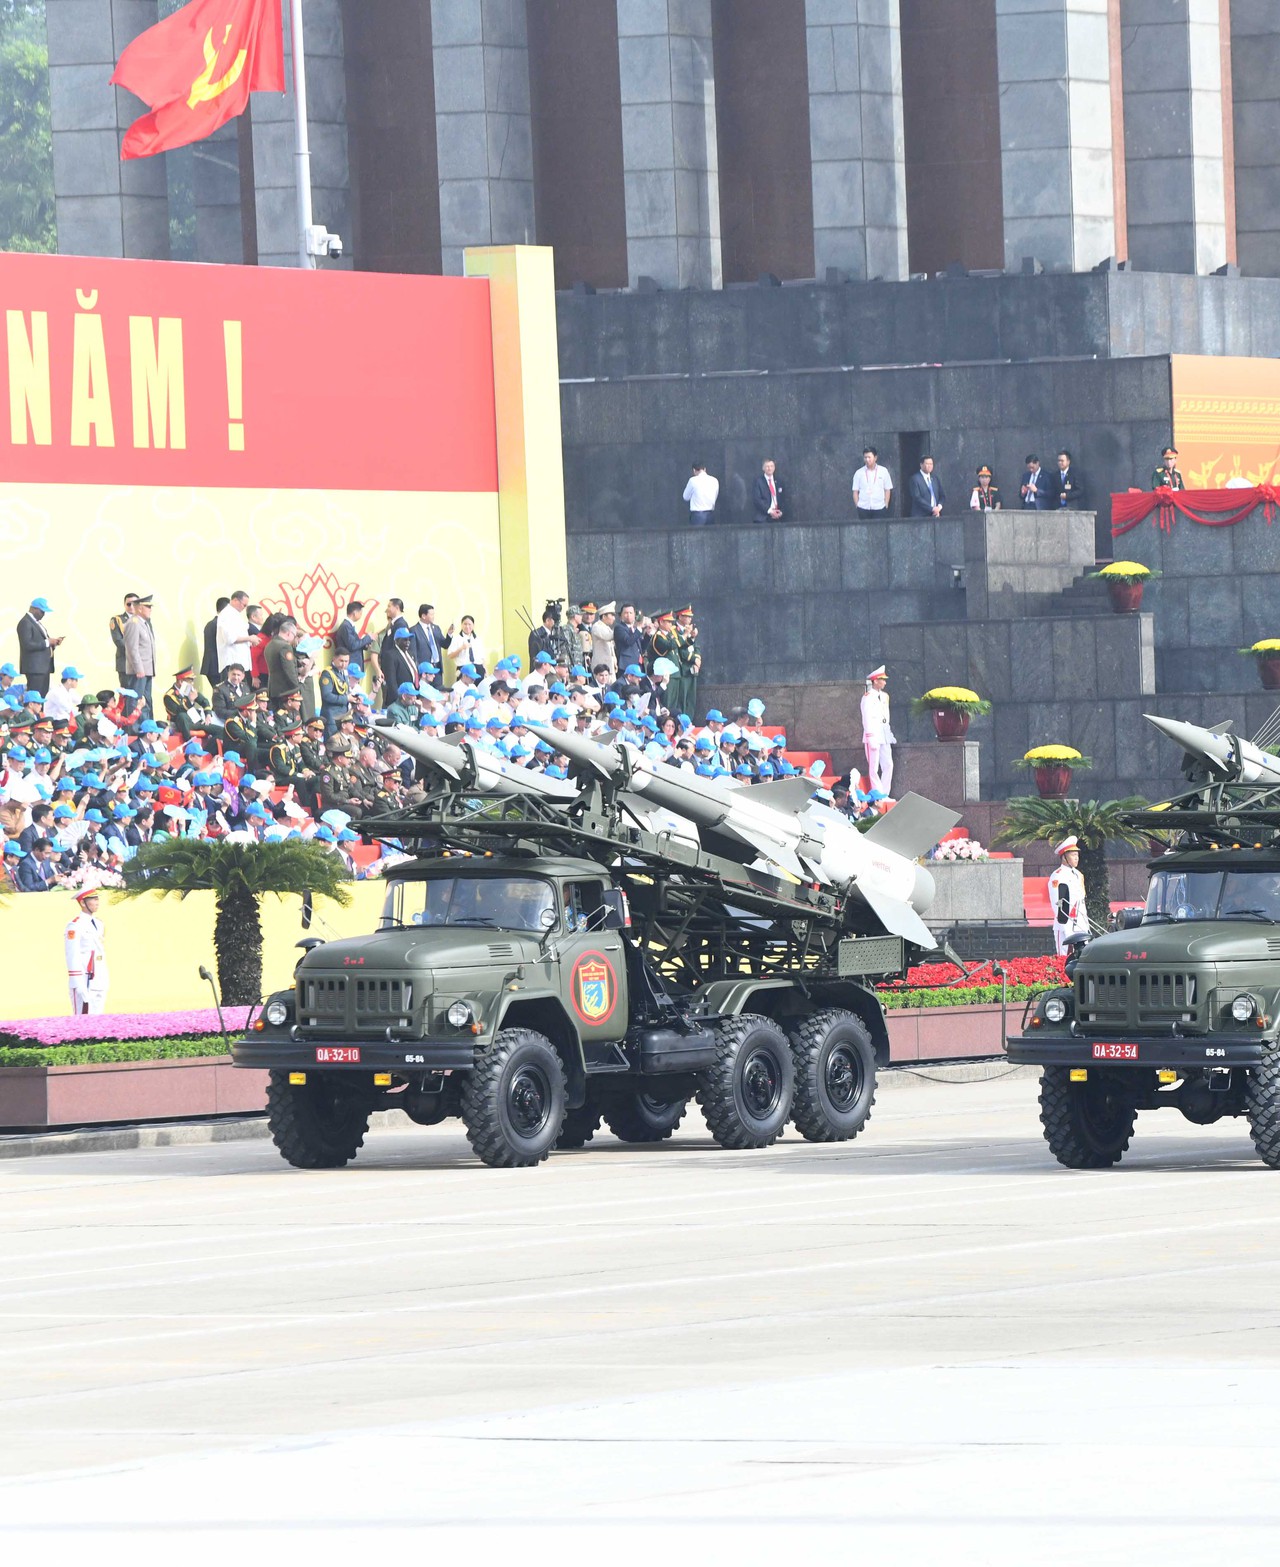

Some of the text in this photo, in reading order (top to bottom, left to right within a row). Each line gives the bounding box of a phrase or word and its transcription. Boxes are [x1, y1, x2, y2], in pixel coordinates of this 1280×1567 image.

[6, 288, 245, 451] NĂM !
[317, 1049, 359, 1061] QA-32-10
[1094, 1045, 1137, 1058] QA-32-54
